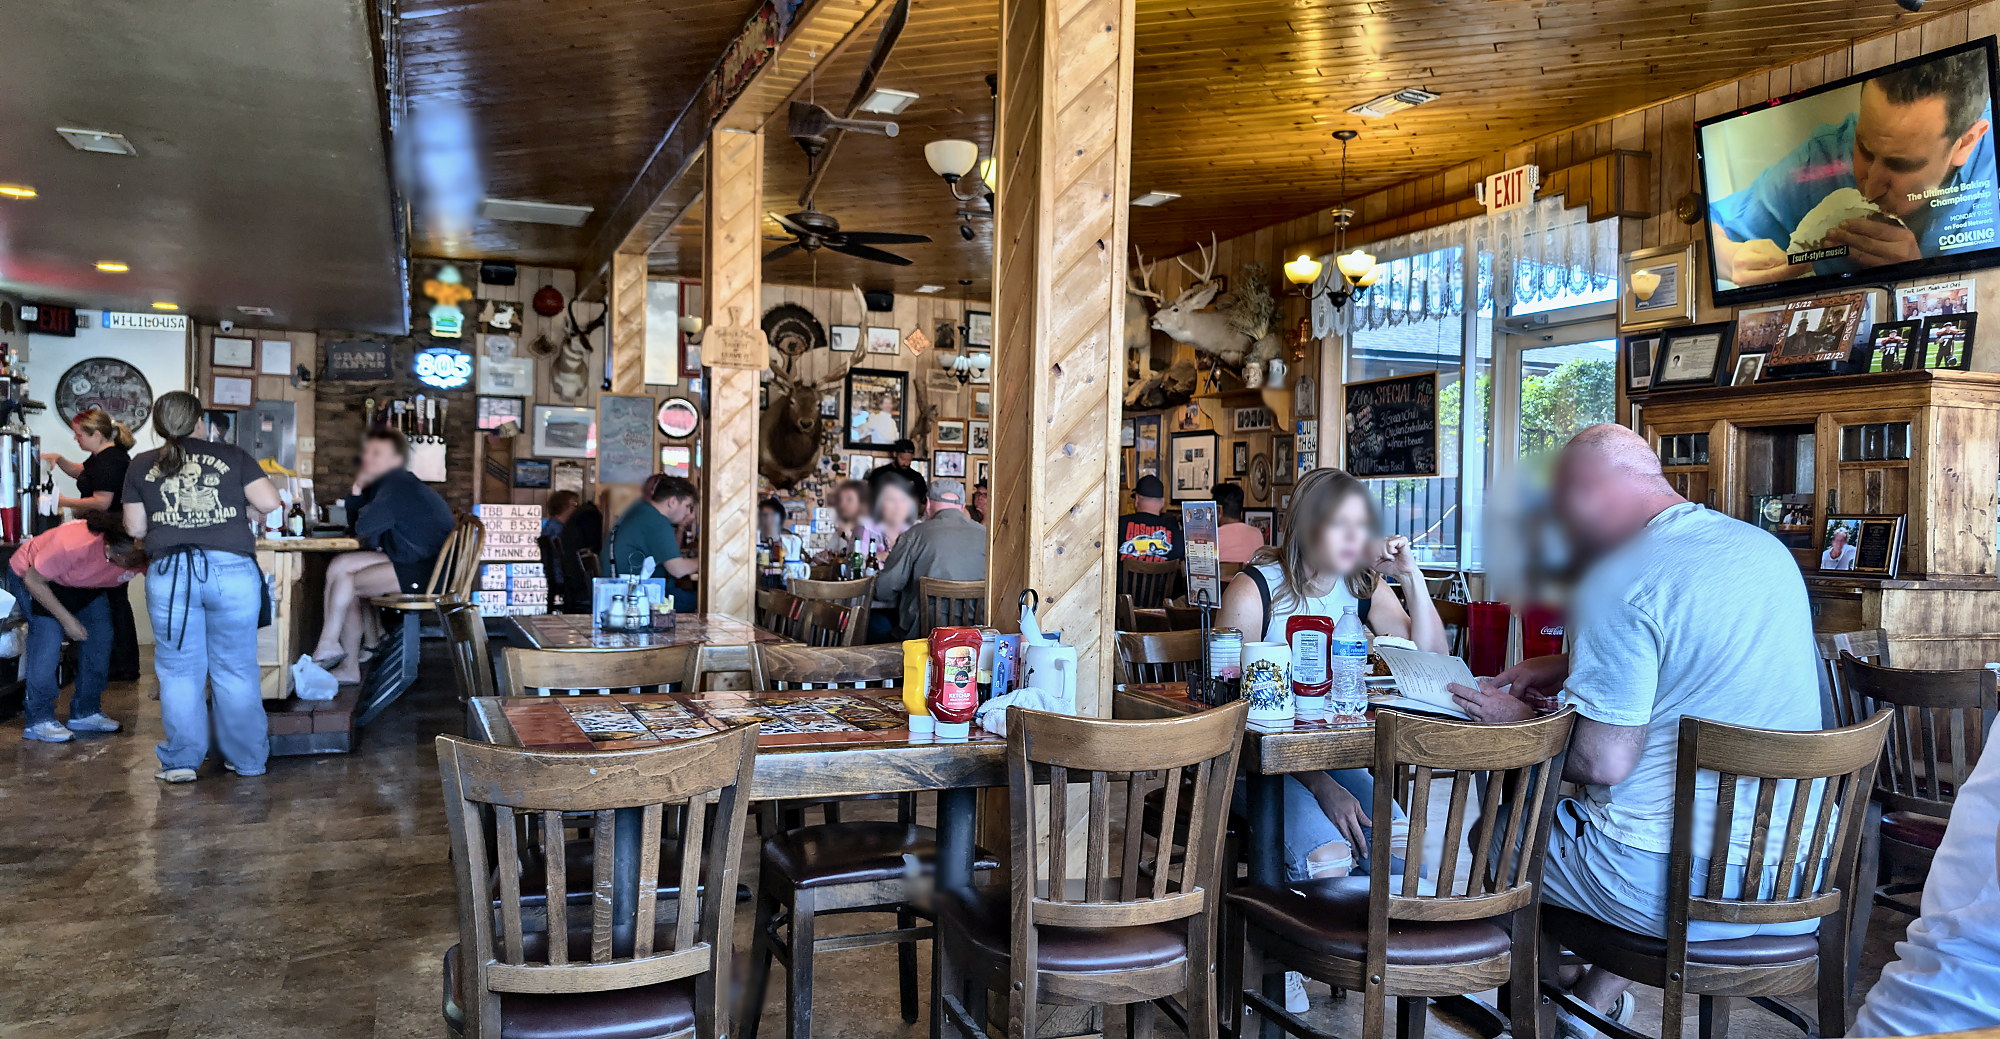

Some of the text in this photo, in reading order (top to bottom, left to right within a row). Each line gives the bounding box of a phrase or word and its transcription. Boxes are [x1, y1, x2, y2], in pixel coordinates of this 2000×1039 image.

[1494, 169, 1523, 209] EXIT
[1906, 180, 1991, 202] The Ultimate Baking
[1930, 190, 1991, 208] Championship
[1949, 211, 1977, 222] MONDAY
[1952, 221, 1968, 230] Food
[1967, 218, 1994, 228] Network
[1938, 227, 1995, 246] COOKING
[1792, 245, 1847, 264] [surf-style music]
[39, 305, 71, 331] EXIT
[1942, 338, 1950, 347] 7
[1816, 351, 1845, 361] 1/12/25
[415, 352, 474, 379] 805
[1376, 383, 1411, 404] SPECIAL
[201, 454, 216, 467] TO
[213, 457, 231, 475] ME
[151, 510, 184, 523] UNTIL
[214, 506, 237, 519] HAD
[484, 534, 524, 545] T-ROLF
[1450, 581, 1457, 597] A
[947, 691, 971, 700] KETCHUP
